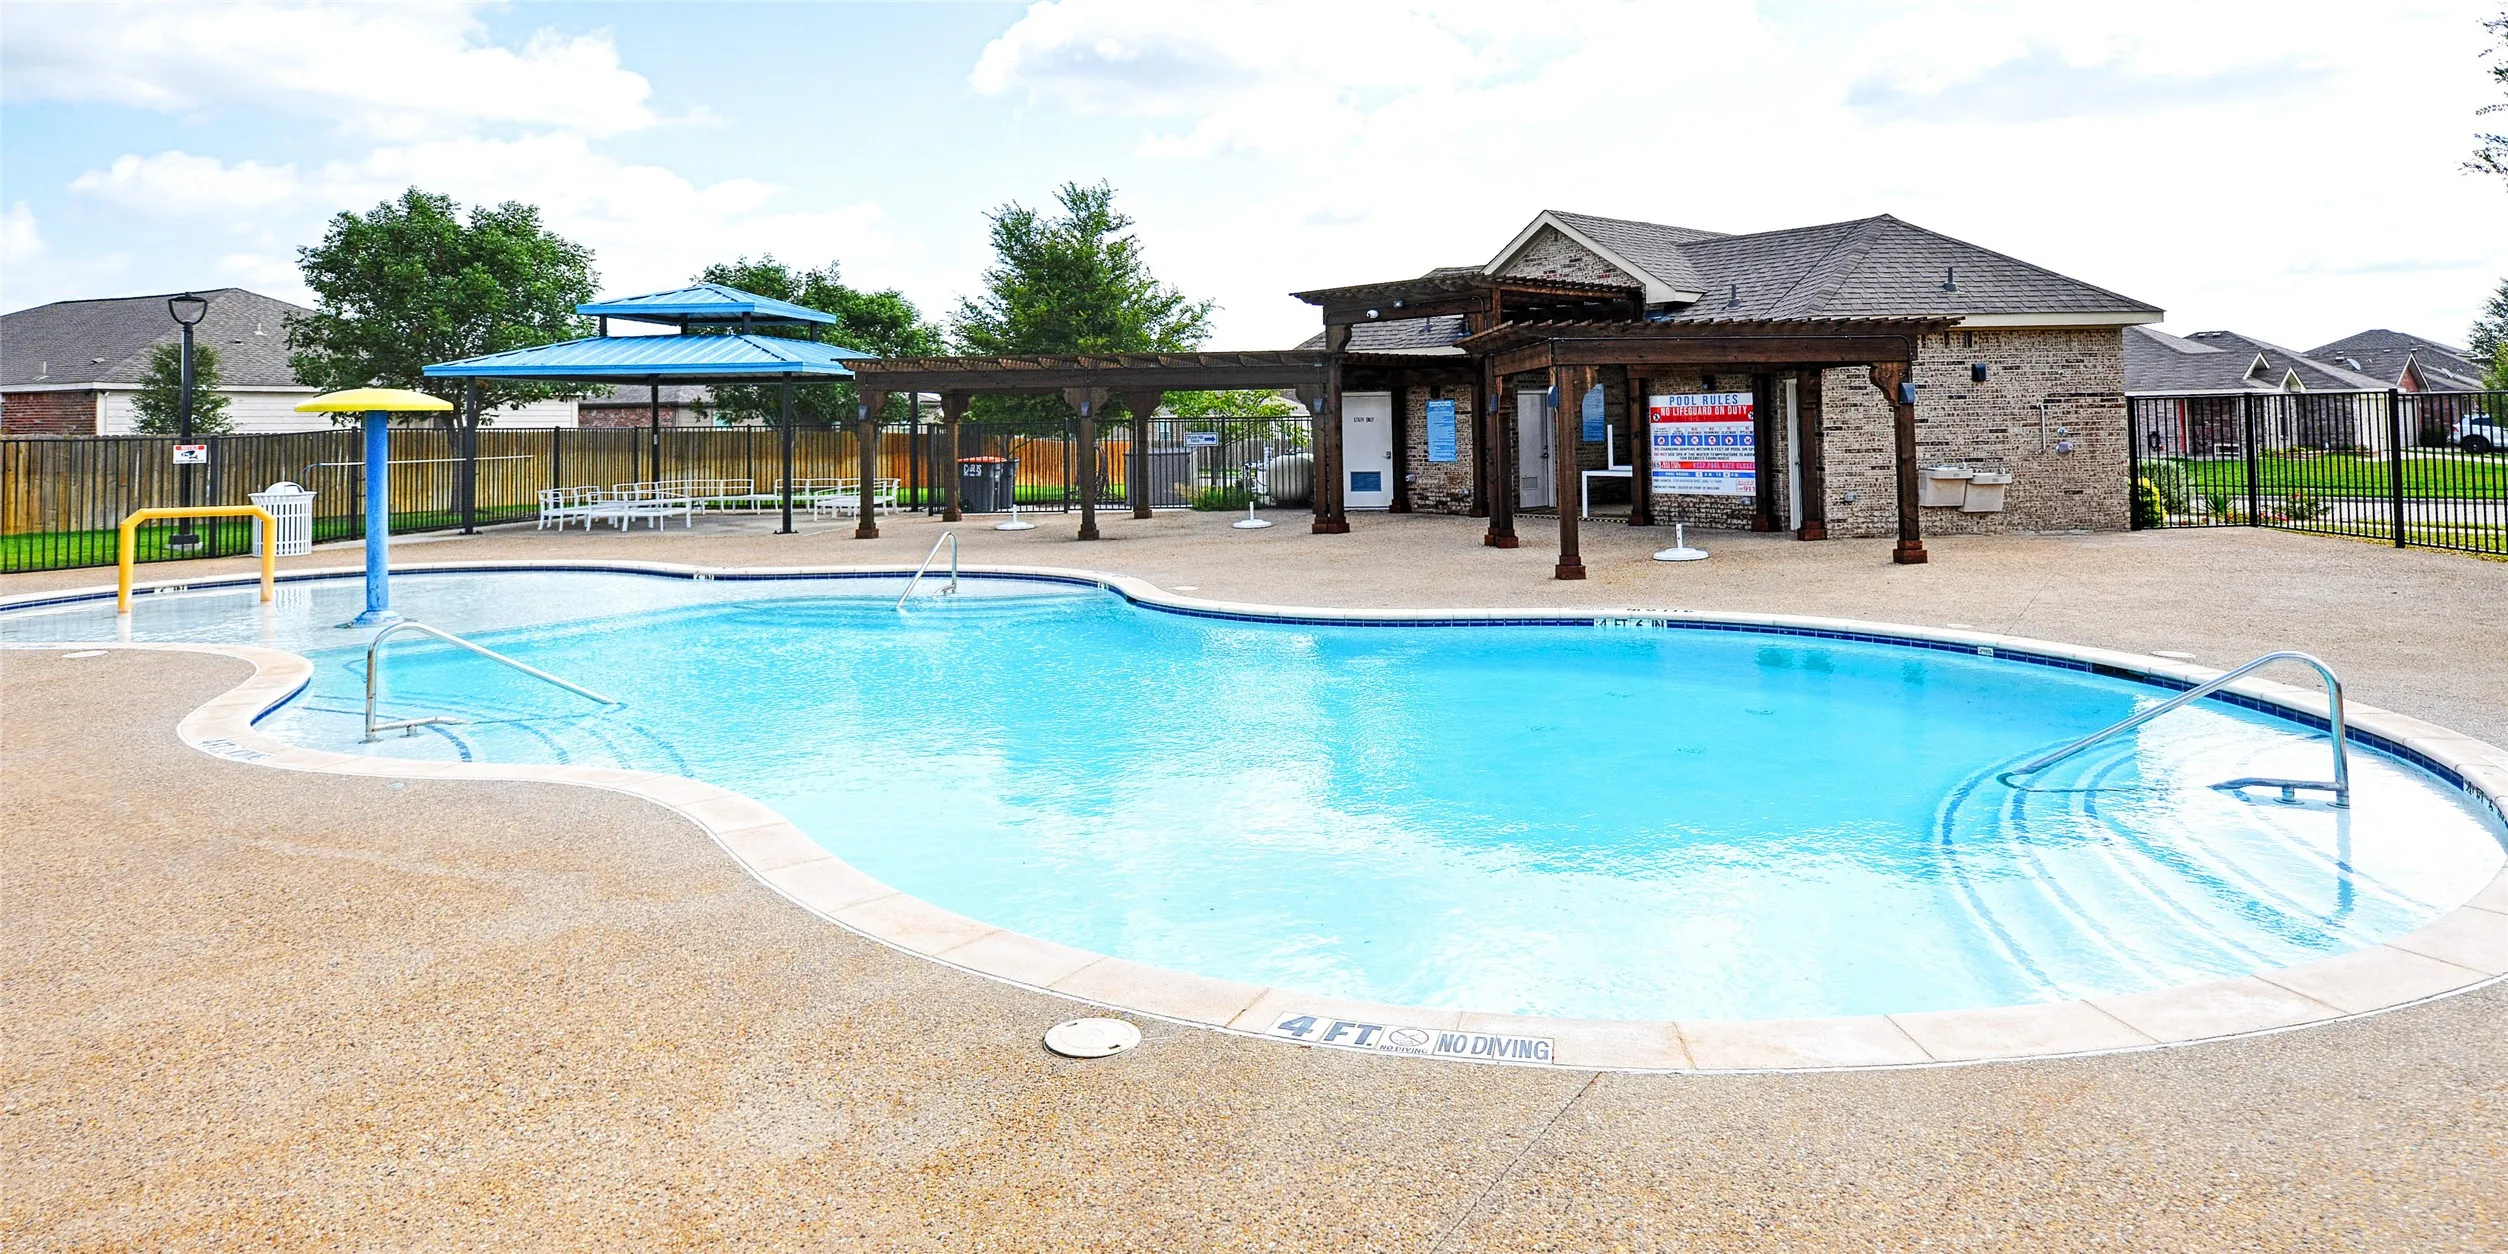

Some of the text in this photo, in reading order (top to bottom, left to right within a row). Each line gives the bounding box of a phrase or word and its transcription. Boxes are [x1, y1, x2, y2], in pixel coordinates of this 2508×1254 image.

[1669, 394, 1738, 406] POOL RULES
[1660, 405, 1748, 416] NO LIFEGUARD ON DUTY
[1651, 619, 1664, 627] IN
[1277, 1015, 1318, 1037] 4
[1395, 1045, 1428, 1054] DIVING
[1437, 1033, 1549, 1061] NO DIVING
